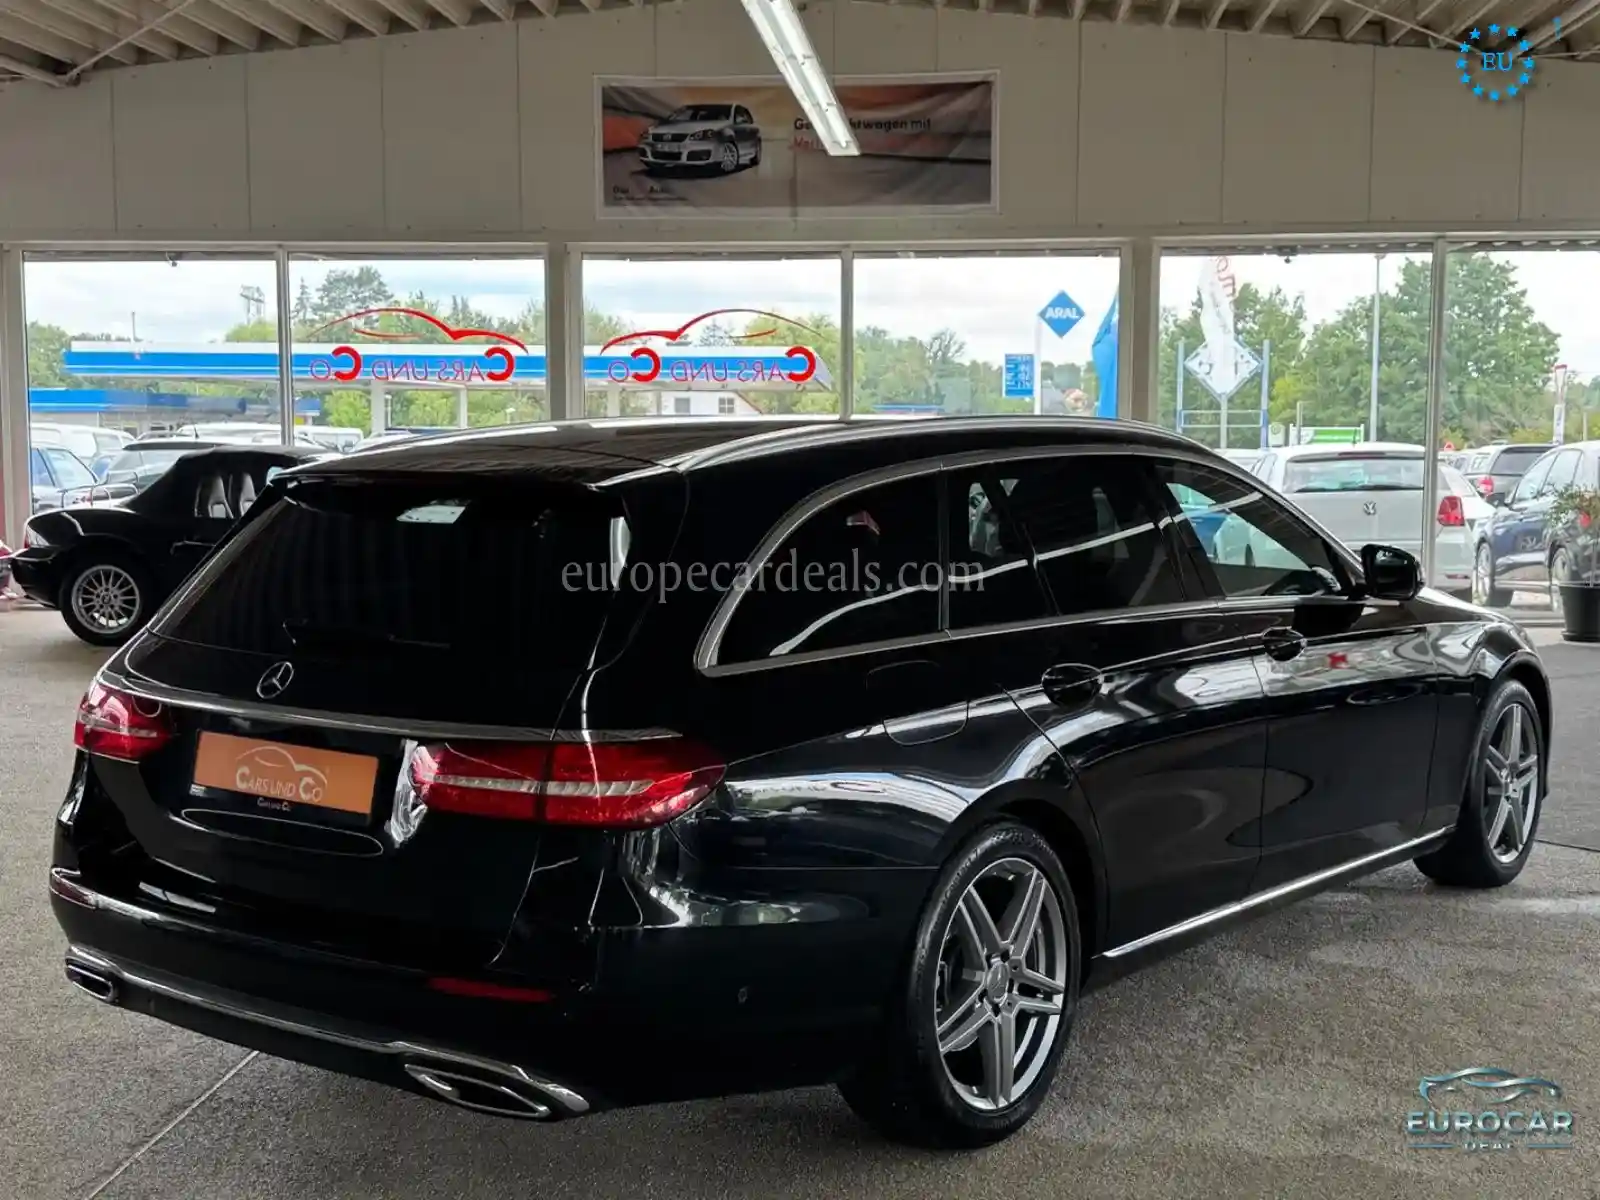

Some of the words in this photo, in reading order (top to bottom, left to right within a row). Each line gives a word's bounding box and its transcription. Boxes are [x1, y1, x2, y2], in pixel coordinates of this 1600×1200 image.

[910, 117, 932, 130] mit
[1045, 307, 1079, 319] ARAL
[270, 779, 296, 797] UND
